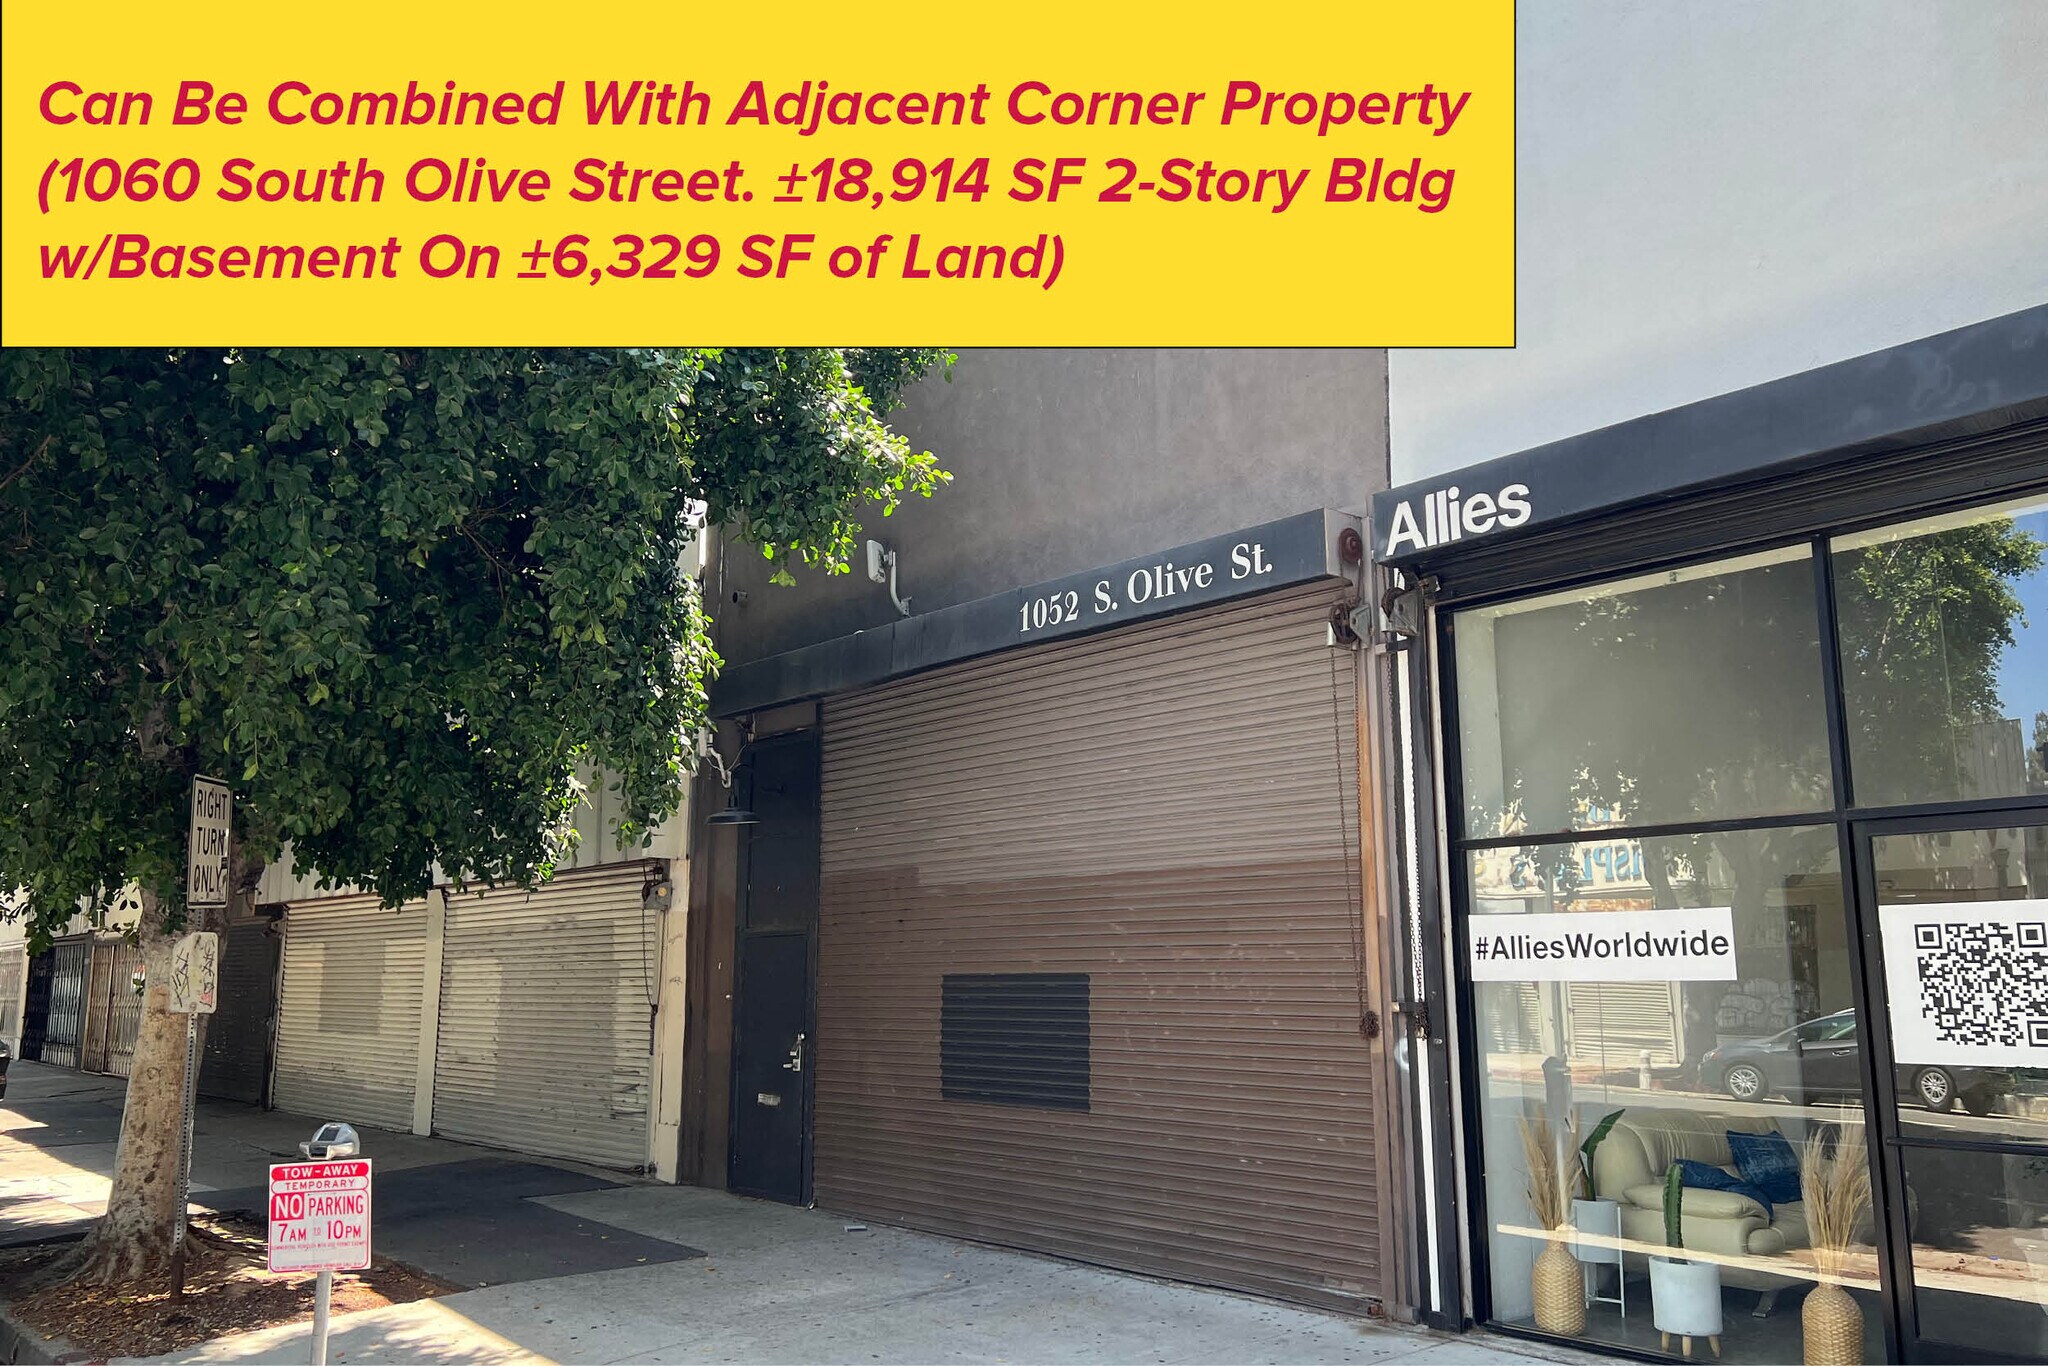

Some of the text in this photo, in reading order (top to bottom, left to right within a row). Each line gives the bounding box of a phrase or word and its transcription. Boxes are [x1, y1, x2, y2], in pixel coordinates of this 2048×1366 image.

[1385, 483, 1533, 558] Allies
[1018, 542, 1273, 633] 1052 S. Olive St.
[196, 789, 228, 820] RIGHT
[197, 827, 226, 855] TURN
[194, 865, 223, 893] ONLY
[1475, 928, 1730, 962] #AlliesWorldwide
[282, 1164, 359, 1180] TOW-AWAY
[285, 1178, 356, 1191] TEMPORARY
[275, 1194, 364, 1219] NO PARKING
